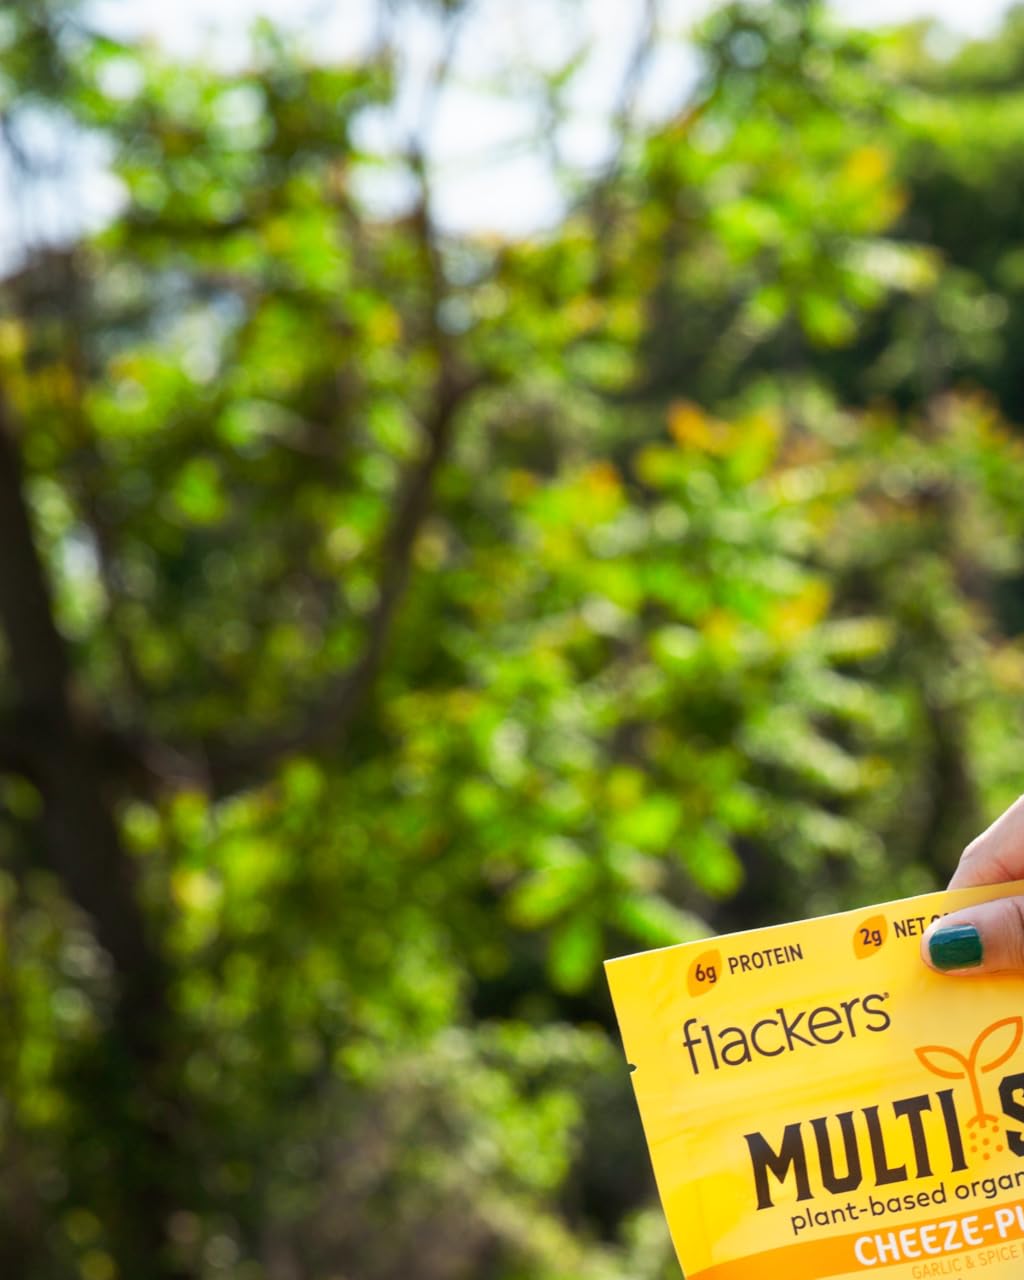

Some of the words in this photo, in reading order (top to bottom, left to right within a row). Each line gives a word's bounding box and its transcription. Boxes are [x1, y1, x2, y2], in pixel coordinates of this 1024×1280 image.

[860, 928, 882, 946] 2g
[893, 916, 926, 938] NET
[695, 964, 717, 983] 6g
[728, 944, 804, 975] PROTEIN
[683, 993, 891, 1075] flackers
[743, 1088, 969, 1211] MULTI
[790, 1182, 947, 1236] plant-based
[911, 1257, 962, 1280] GARLIC
[966, 1256, 975, 1269] &
[978, 1248, 1019, 1267] SPICE
